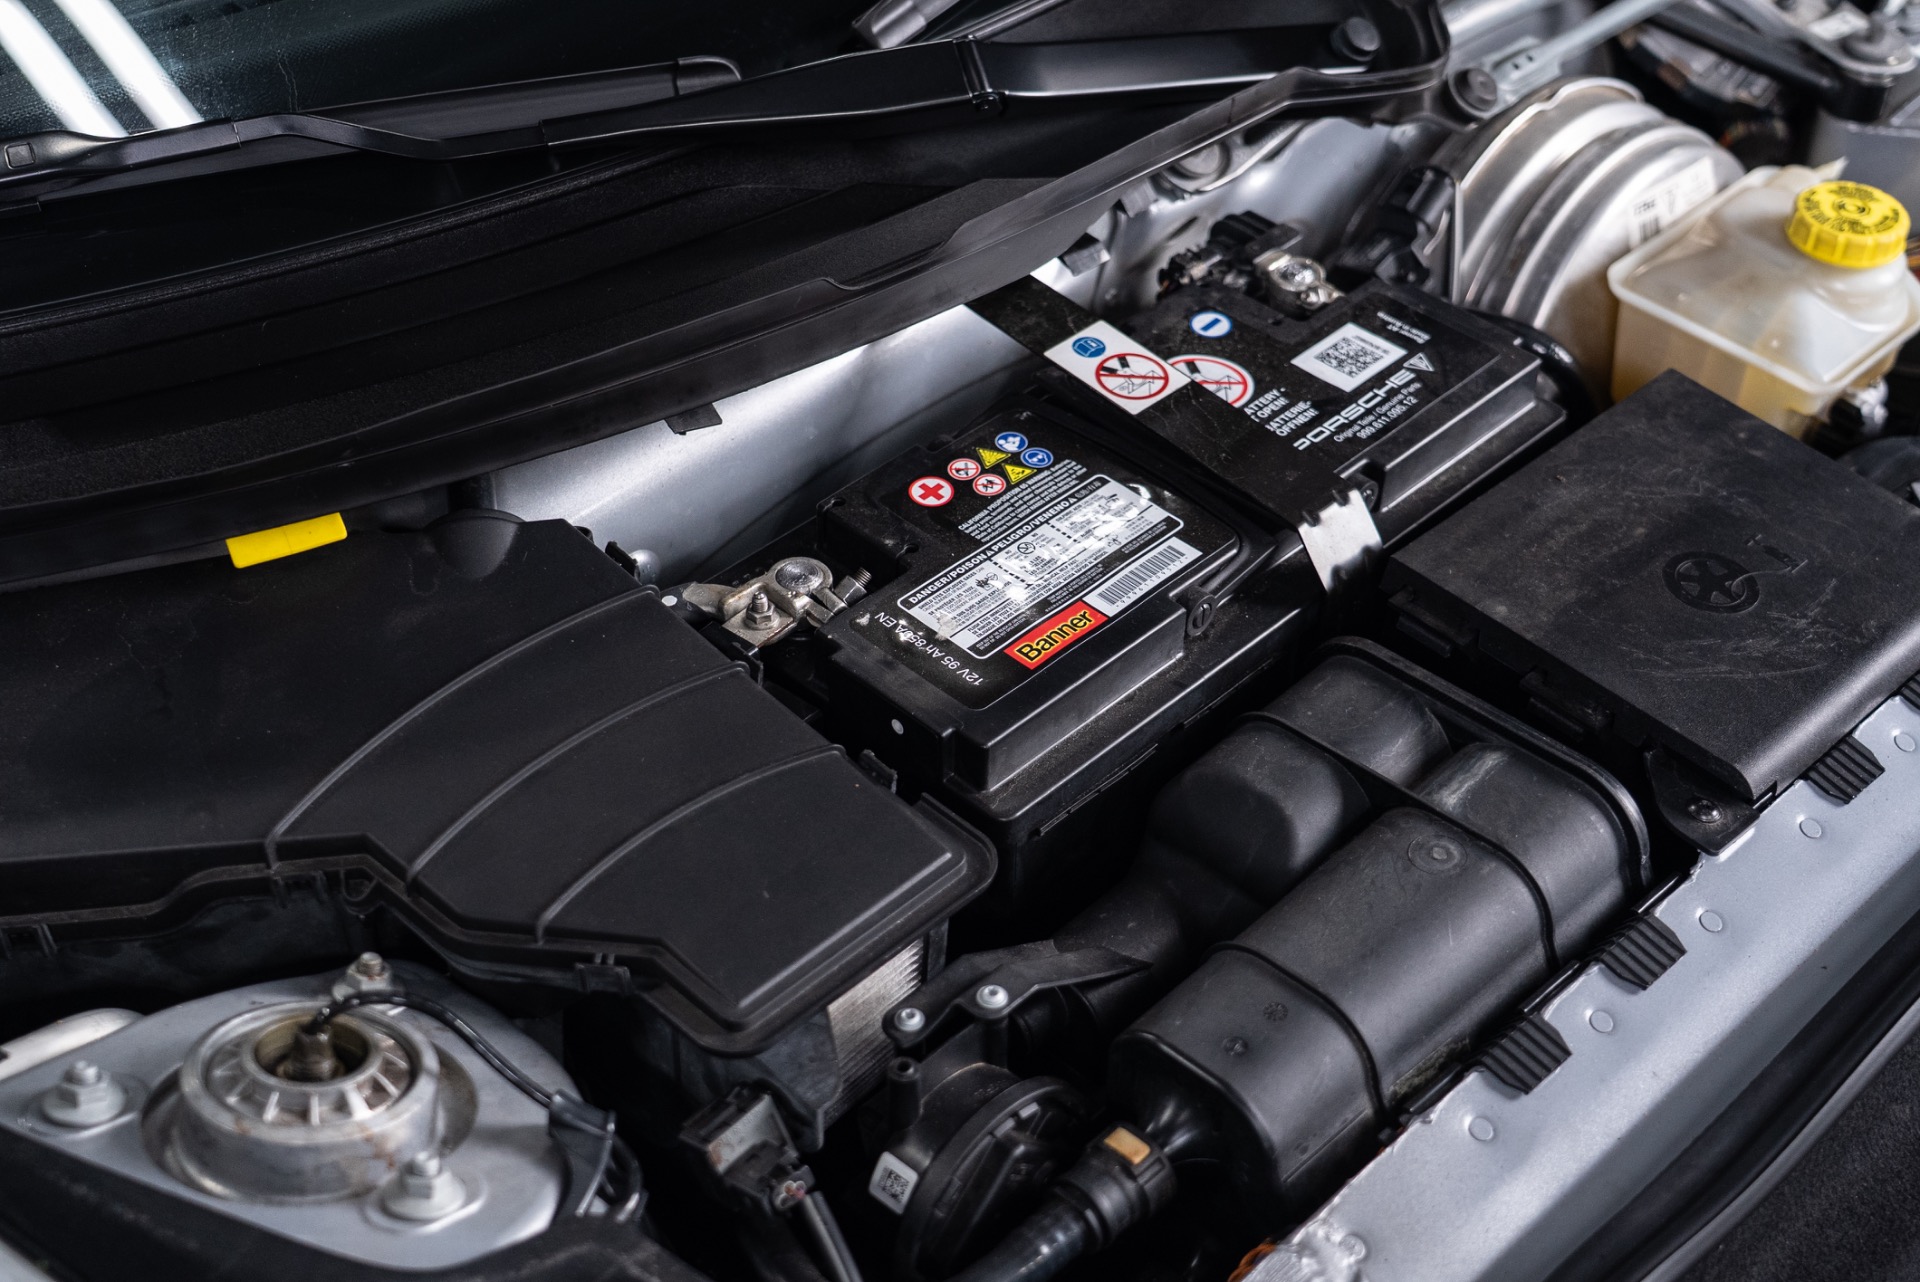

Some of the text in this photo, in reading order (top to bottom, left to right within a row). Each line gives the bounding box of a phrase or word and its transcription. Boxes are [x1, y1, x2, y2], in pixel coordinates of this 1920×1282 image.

[1244, 388, 1281, 415] ATTERY
[1334, 423, 1361, 442] Original
[1357, 414, 1376, 427] Teile
[1376, 393, 1405, 415] Genuine
[1400, 382, 1422, 396] Parts
[1356, 395, 1419, 439] 999.611.095.12
[956, 508, 991, 530] CALIFORNIA
[985, 486, 1023, 511] PROPOSITION
[990, 500, 1070, 552] PELIGRO/VENENO
[907, 552, 989, 603] DANGER/POISON
[874, 611, 898, 628] EN
[1015, 609, 1093, 662] Banner
[925, 644, 945, 659] Ah
[940, 656, 961, 671] 95
[956, 668, 984, 686] 12V
